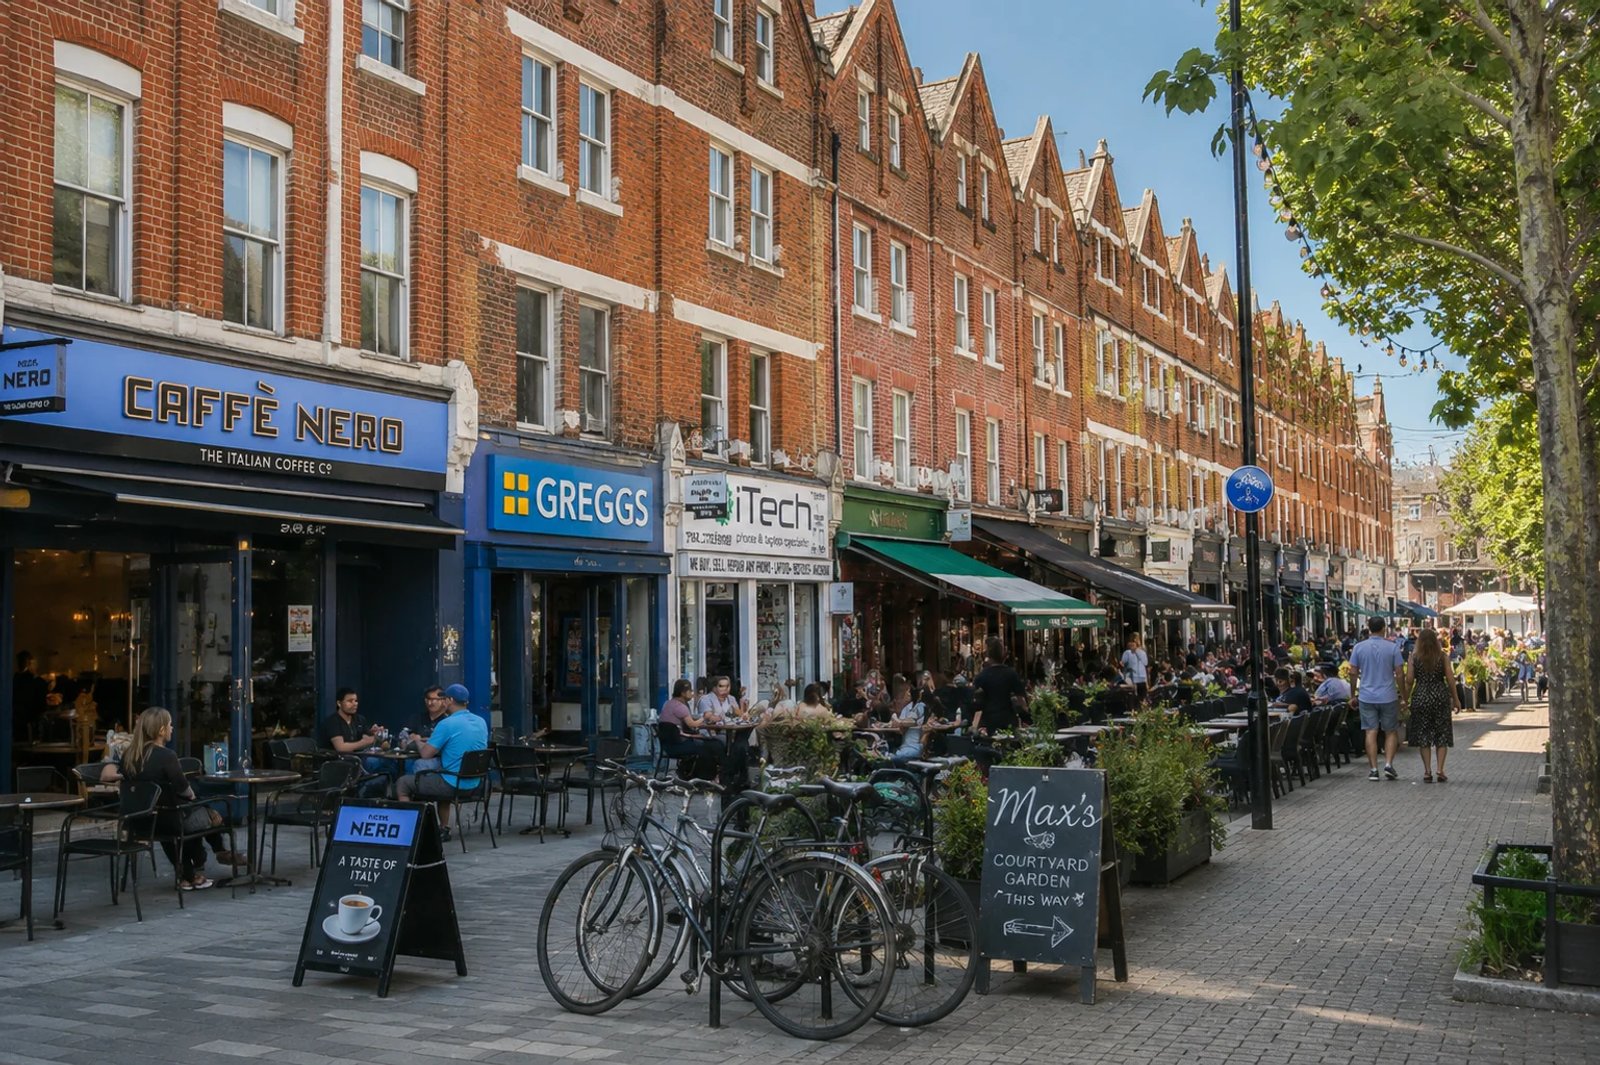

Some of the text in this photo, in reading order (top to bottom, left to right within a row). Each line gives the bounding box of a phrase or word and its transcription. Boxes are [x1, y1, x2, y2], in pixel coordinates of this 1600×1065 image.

[3, 369, 50, 390] NERO
[123, 375, 404, 454] CAFFÈ NERO
[200, 448, 223, 464] THE
[227, 451, 271, 468] ITALIAN
[275, 457, 315, 474] COFFEE
[536, 476, 649, 527] GREGGS
[736, 485, 812, 531] iTech
[993, 785, 1101, 834] Max's
[350, 820, 401, 839] NERO
[338, 855, 398, 871] A TASTE OF
[993, 853, 1089, 872] COURTYARD
[350, 870, 381, 884] ITALY
[1004, 872, 1070, 889] GARDEN
[1003, 892, 1070, 907] THIS WAY
